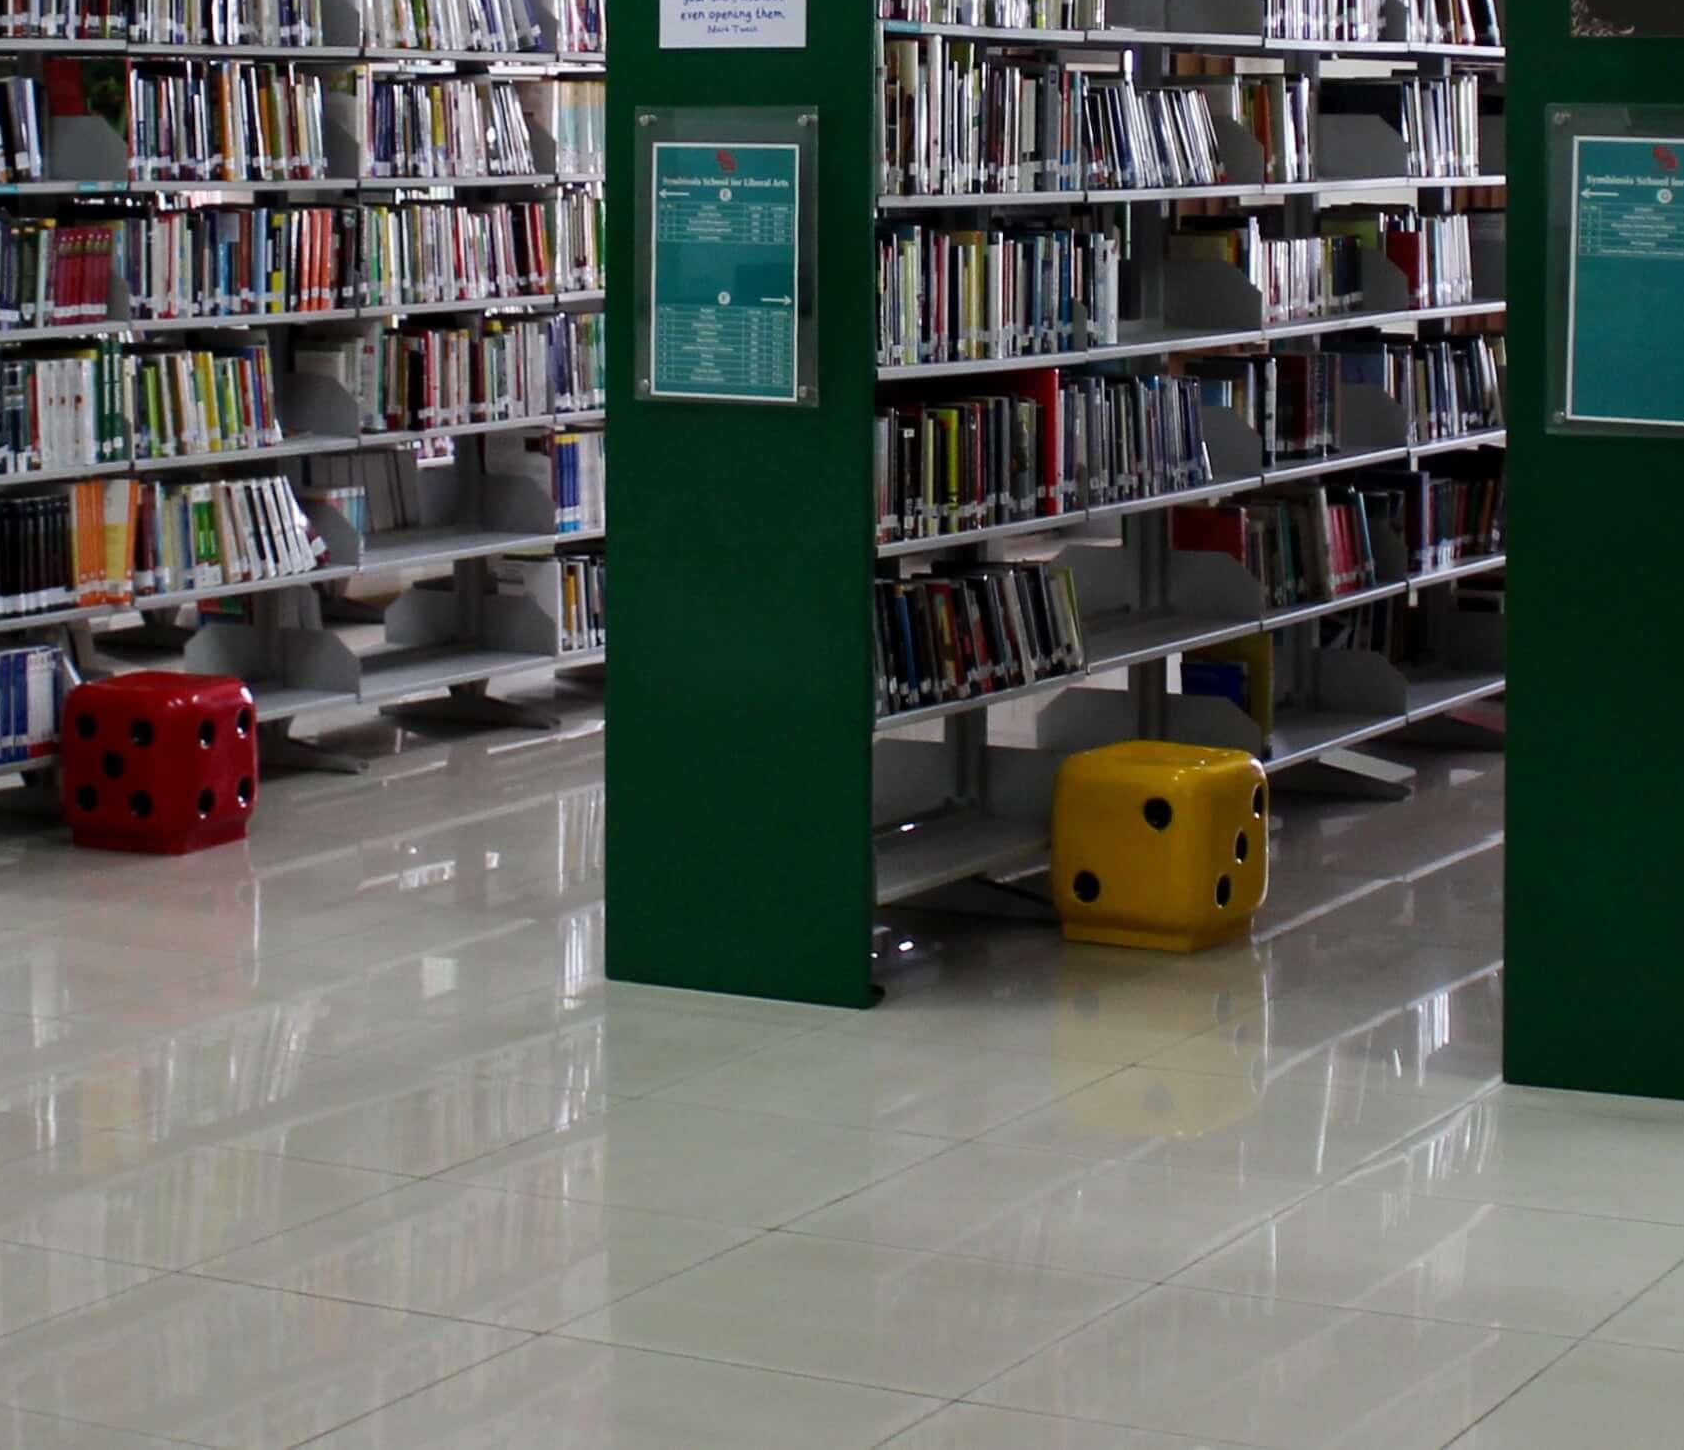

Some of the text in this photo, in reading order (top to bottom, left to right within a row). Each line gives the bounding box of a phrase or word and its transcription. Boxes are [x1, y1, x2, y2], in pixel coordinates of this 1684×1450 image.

[681, 11, 705, 20] even
[709, 9, 751, 22] opening
[1637, 176, 1669, 186] School
[1671, 176, 1684, 187] for
